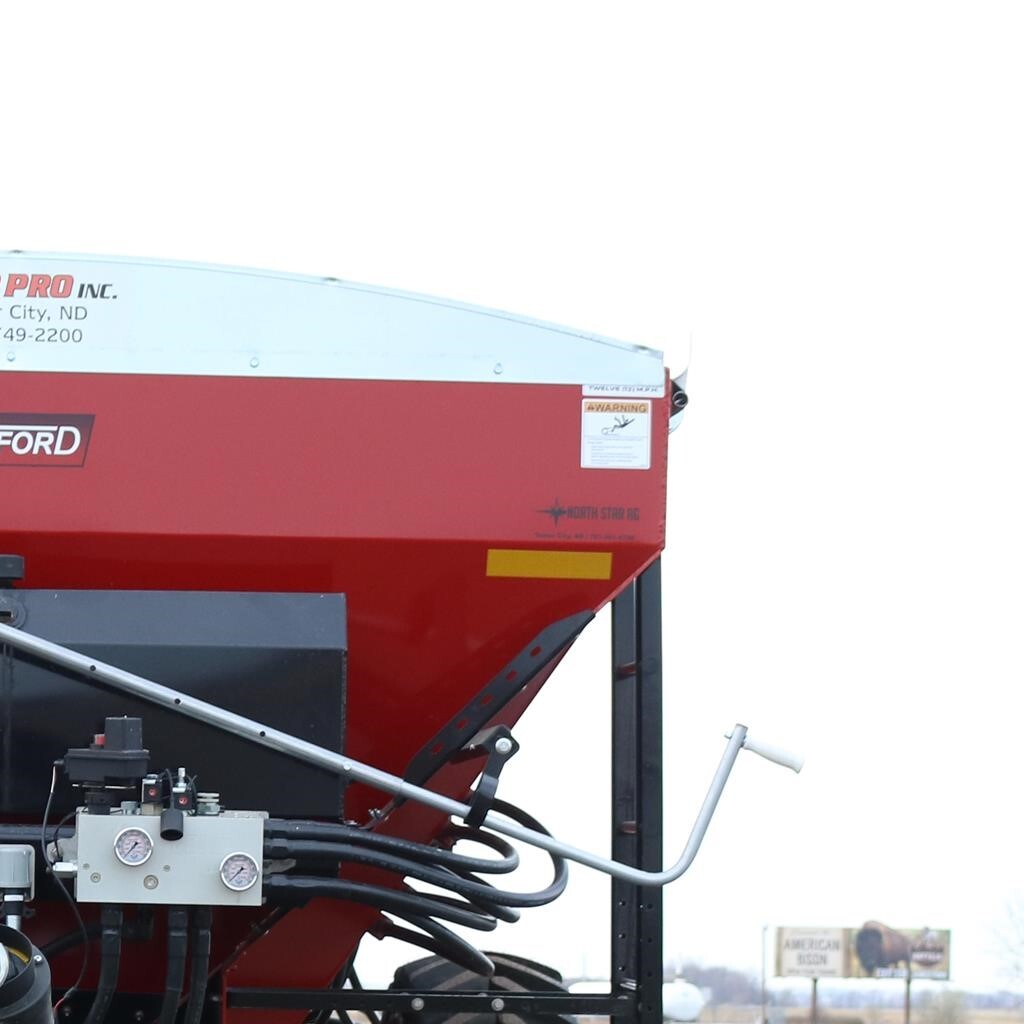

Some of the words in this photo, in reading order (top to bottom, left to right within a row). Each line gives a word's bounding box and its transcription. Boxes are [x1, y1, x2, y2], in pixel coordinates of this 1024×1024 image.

[3, 273, 74, 299] PRO
[77, 282, 118, 300] INC.
[9, 304, 52, 322] City,
[59, 306, 88, 321] ND
[594, 402, 647, 413] WARNING
[600, 507, 625, 521] STAR
[784, 938, 840, 951] AMERICAN
